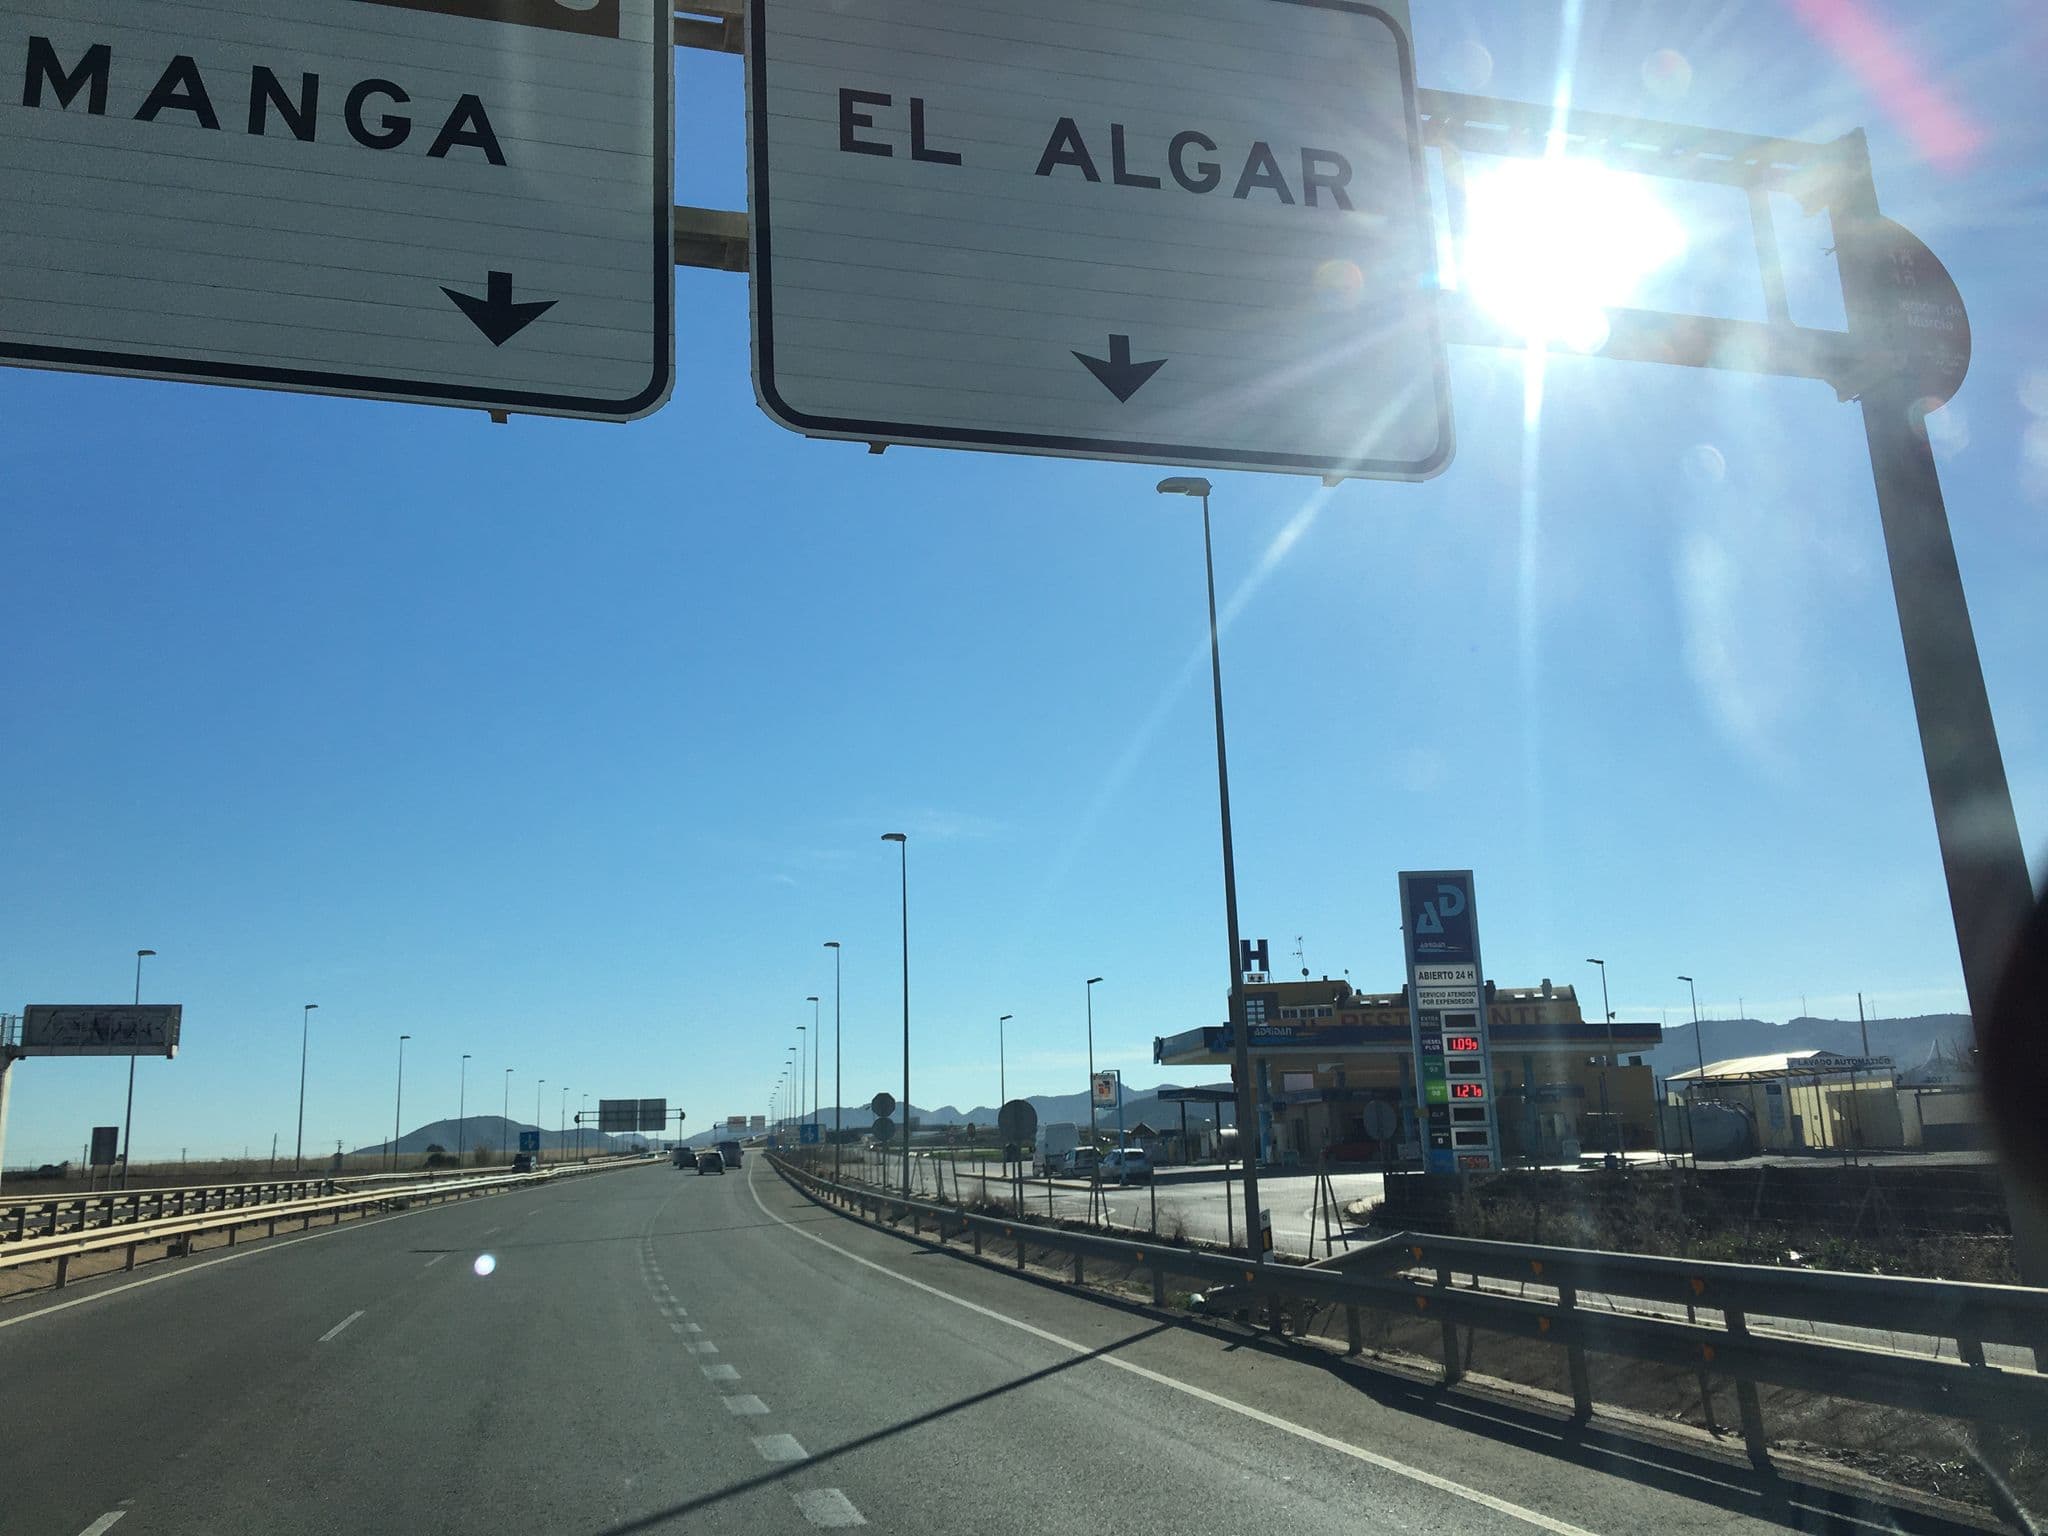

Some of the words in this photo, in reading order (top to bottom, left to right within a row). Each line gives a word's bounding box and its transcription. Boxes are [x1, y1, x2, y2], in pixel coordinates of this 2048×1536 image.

[22, 36, 507, 166] MANGA
[839, 87, 962, 166] EL
[1035, 116, 1355, 211] ALGAR
[1240, 939, 1269, 972] H
[1418, 971, 1454, 980] ABIERTO
[1455, 971, 1466, 979] 24
[1467, 970, 1474, 979] H
[1798, 1057, 1832, 1066] LAVADO
